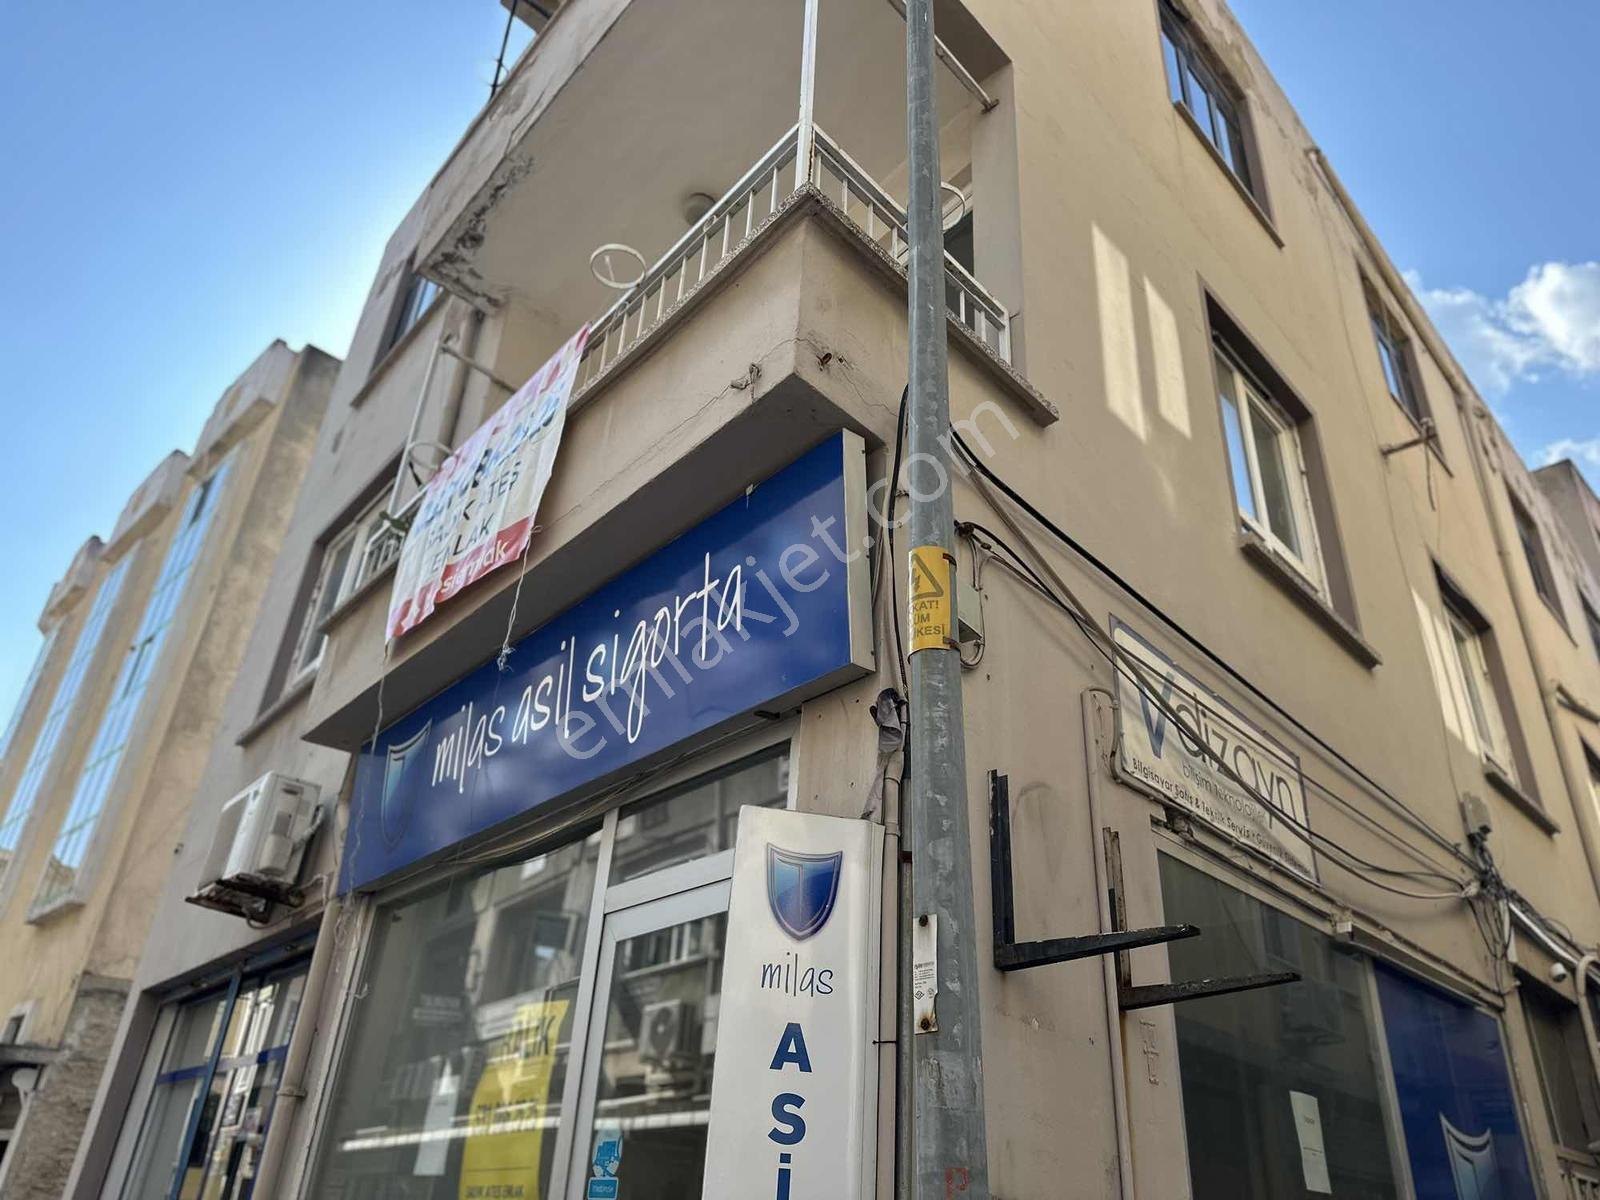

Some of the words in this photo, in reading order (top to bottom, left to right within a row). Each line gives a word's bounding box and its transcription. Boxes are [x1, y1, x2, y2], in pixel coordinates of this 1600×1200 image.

[432, 701, 505, 794] milas
[511, 635, 576, 745] asil
[582, 552, 742, 745] sigorta
[1132, 757, 1173, 792] Bilgisayar
[1226, 816, 1250, 839] Servis
[761, 951, 834, 997] milas
